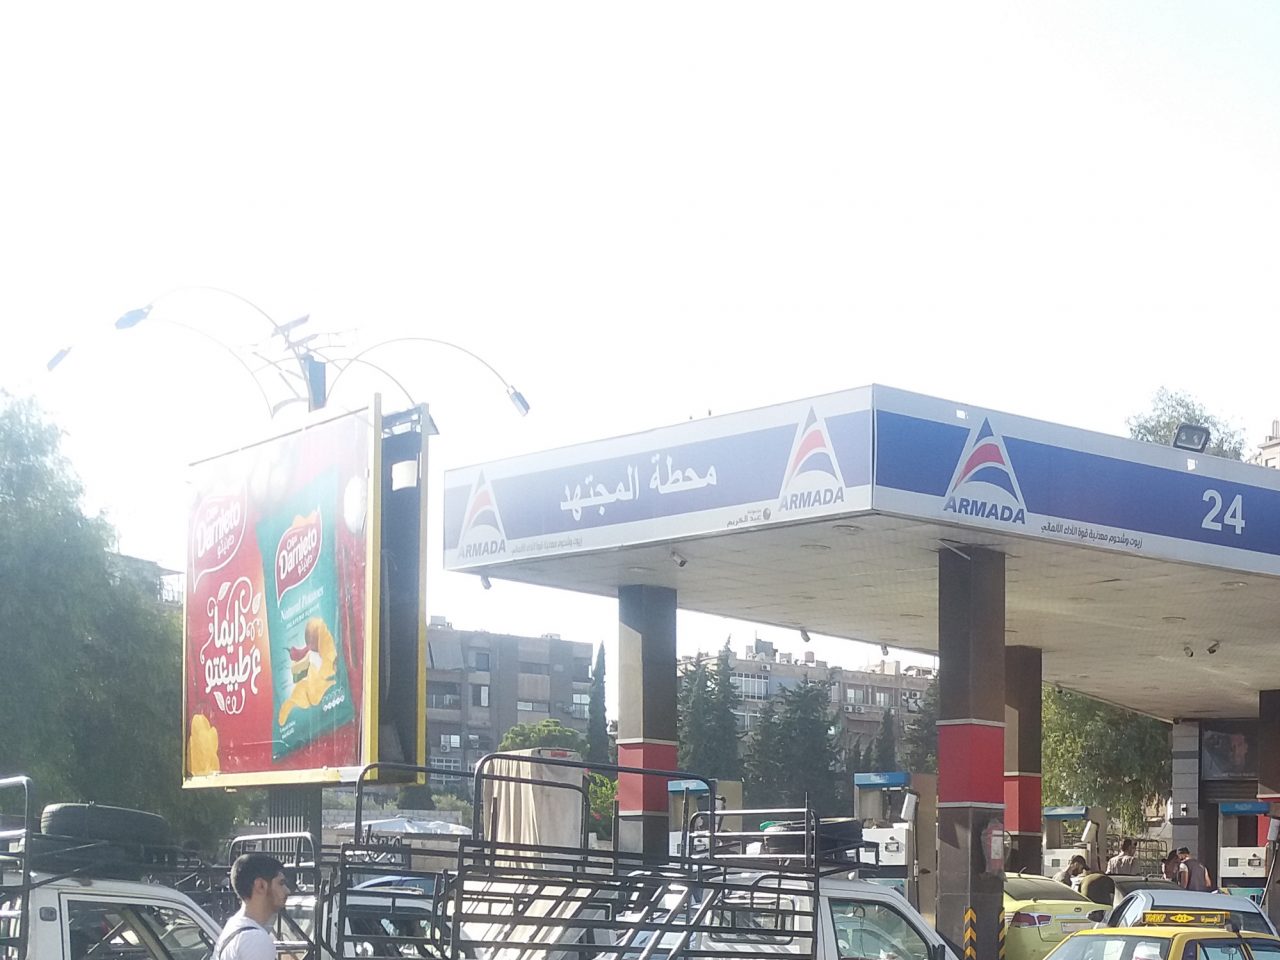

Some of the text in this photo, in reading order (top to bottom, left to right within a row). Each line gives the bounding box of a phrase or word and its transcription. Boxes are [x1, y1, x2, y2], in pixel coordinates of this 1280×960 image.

[561, 453, 717, 522] محطة المجتهد
[779, 487, 845, 512] ARMADA
[944, 496, 1026, 525] ARMADA
[1201, 489, 1246, 535] 24
[459, 539, 506, 559] ARMADA
